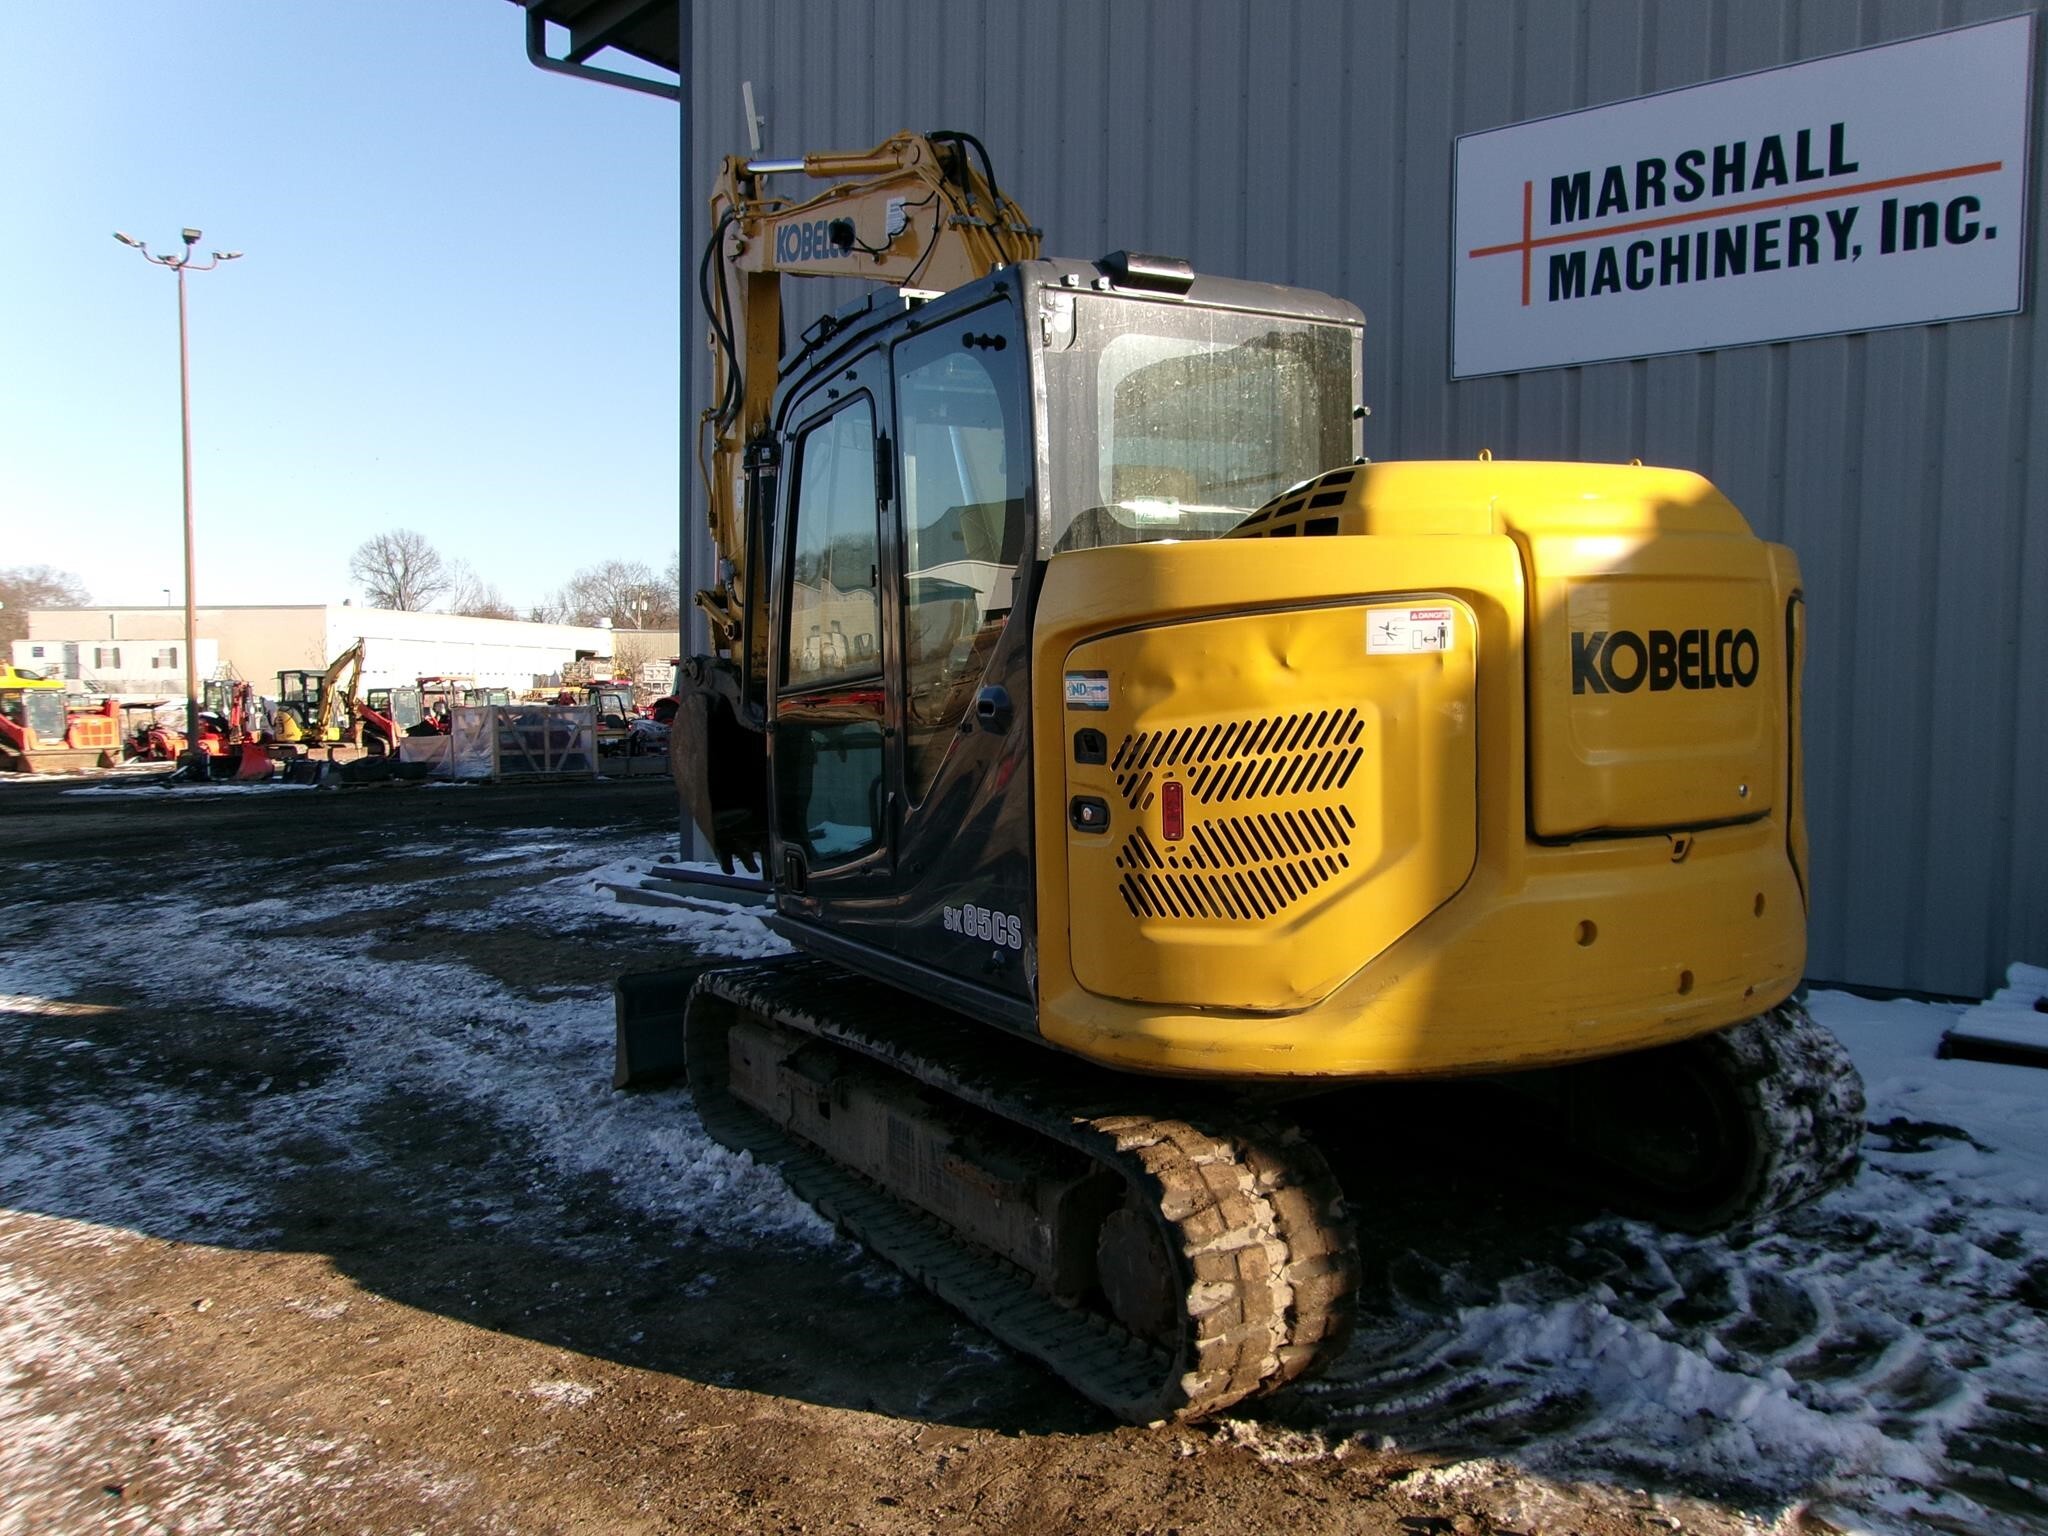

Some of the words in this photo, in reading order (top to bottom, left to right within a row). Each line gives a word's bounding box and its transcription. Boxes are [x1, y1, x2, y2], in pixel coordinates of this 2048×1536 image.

[1549, 121, 1859, 226] MARSHALL
[1548, 206, 1863, 302] MACHINERY,
[1881, 195, 1997, 255] Inc.
[1571, 628, 1760, 695] KOBELCO
[943, 903, 1022, 950] SK85CS
